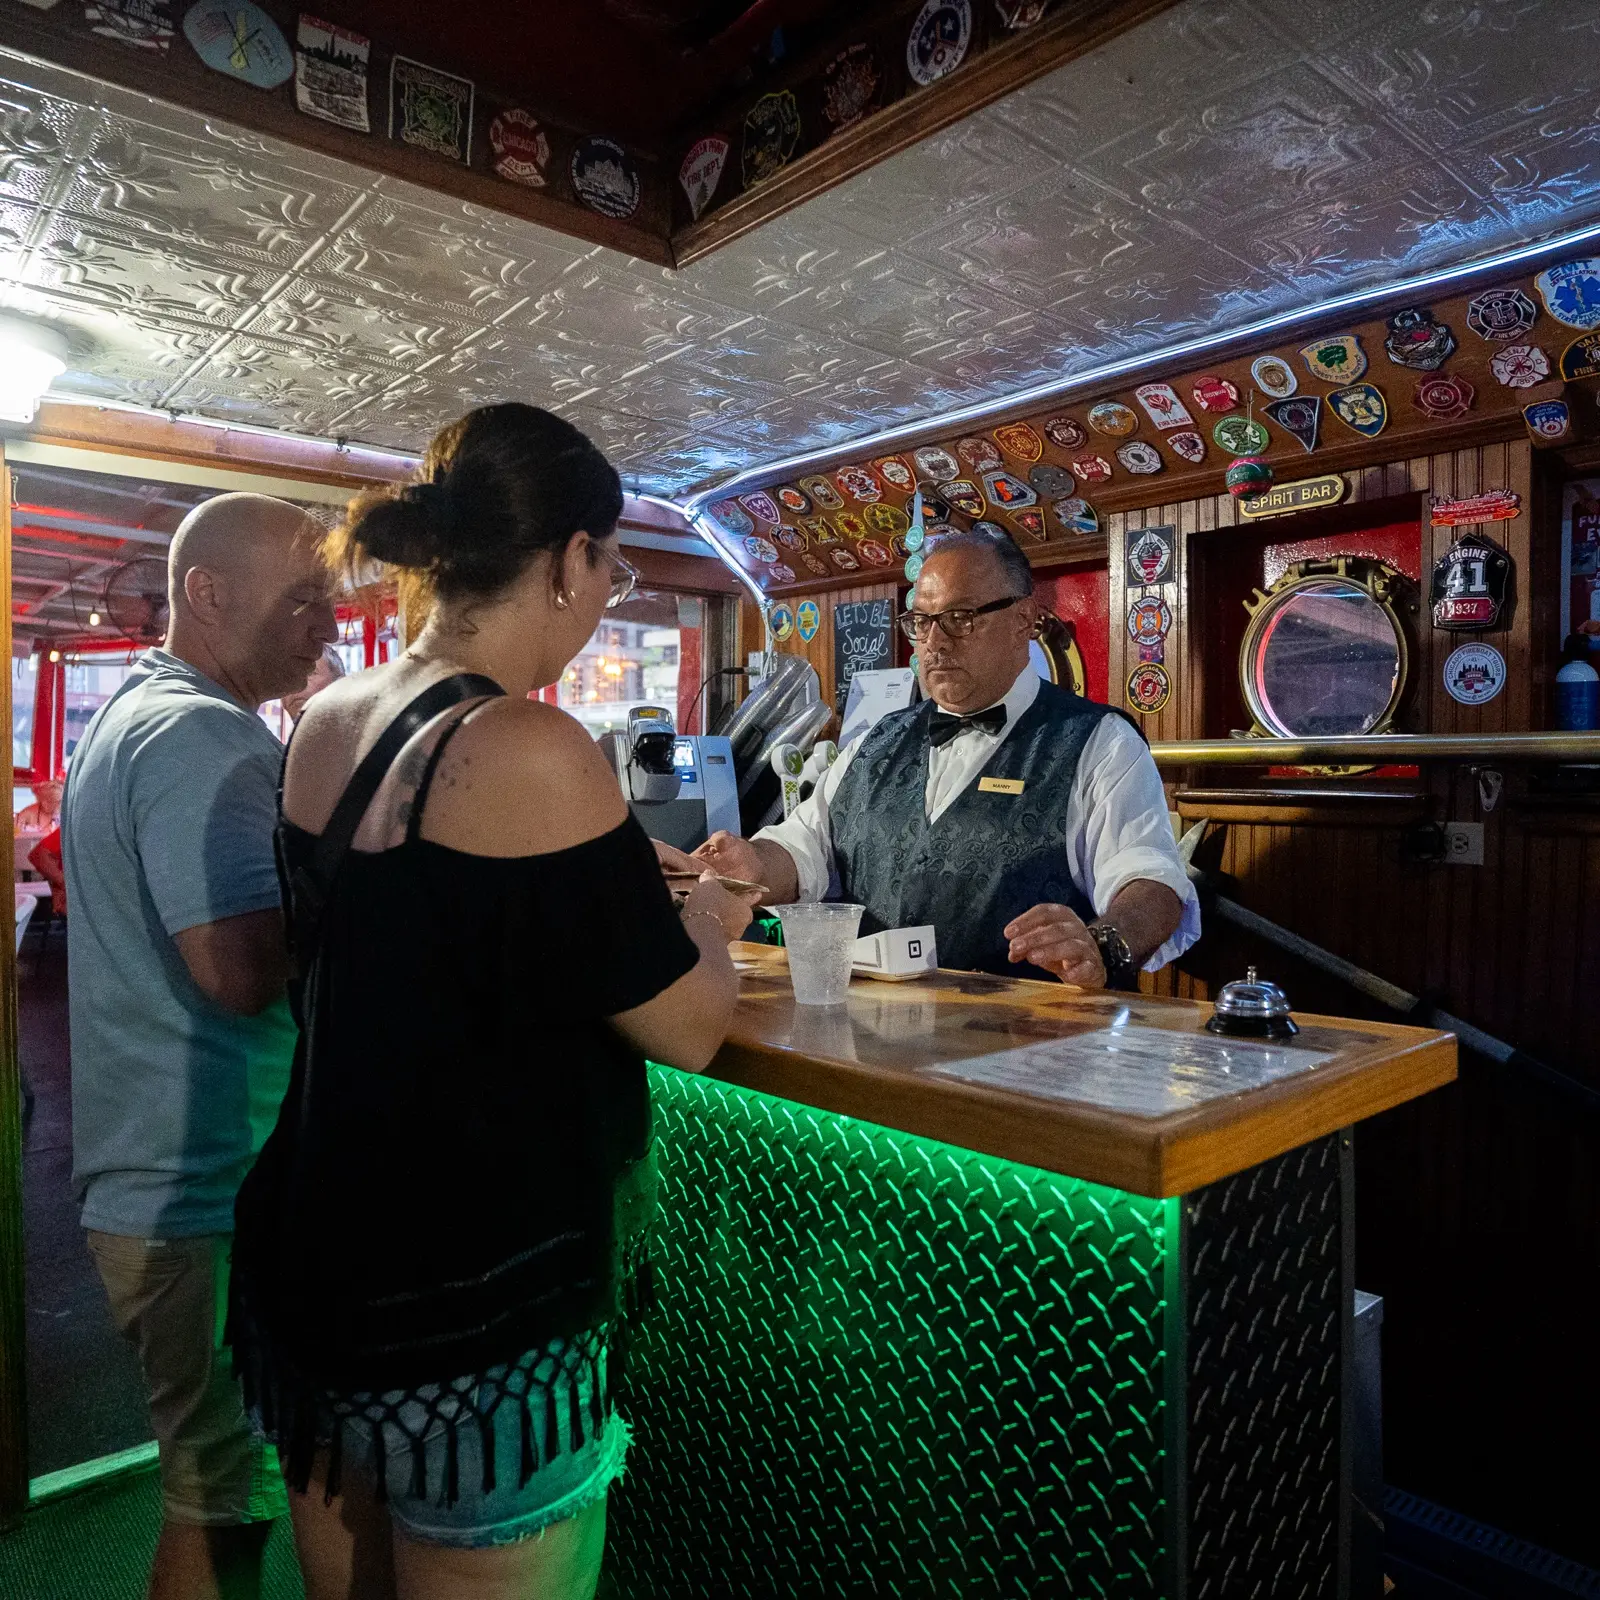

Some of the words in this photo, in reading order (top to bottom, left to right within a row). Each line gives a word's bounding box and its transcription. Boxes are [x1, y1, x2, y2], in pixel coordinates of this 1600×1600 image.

[1548, 260, 1592, 281] EMT
[1322, 338, 1350, 347] JERSEY
[1501, 349, 1526, 359] LENA
[1573, 365, 1597, 376] FIRE
[1252, 490, 1295, 509] SPIRIT
[1301, 484, 1331, 501] BAR
[1579, 514, 1600, 528] FU
[1448, 548, 1489, 563] ENGINE
[1446, 562, 1488, 594] 41
[1139, 598, 1159, 606] CHICAGO
[1449, 602, 1478, 616] 1937
[869, 602, 891, 629] BE
[842, 629, 889, 657] Social
[1137, 665, 1159, 674] CHICAGO
[1448, 653, 1463, 680] CHICAGO
[1462, 647, 1493, 658] FIREBOAT
[1490, 655, 1502, 677] TOURS
